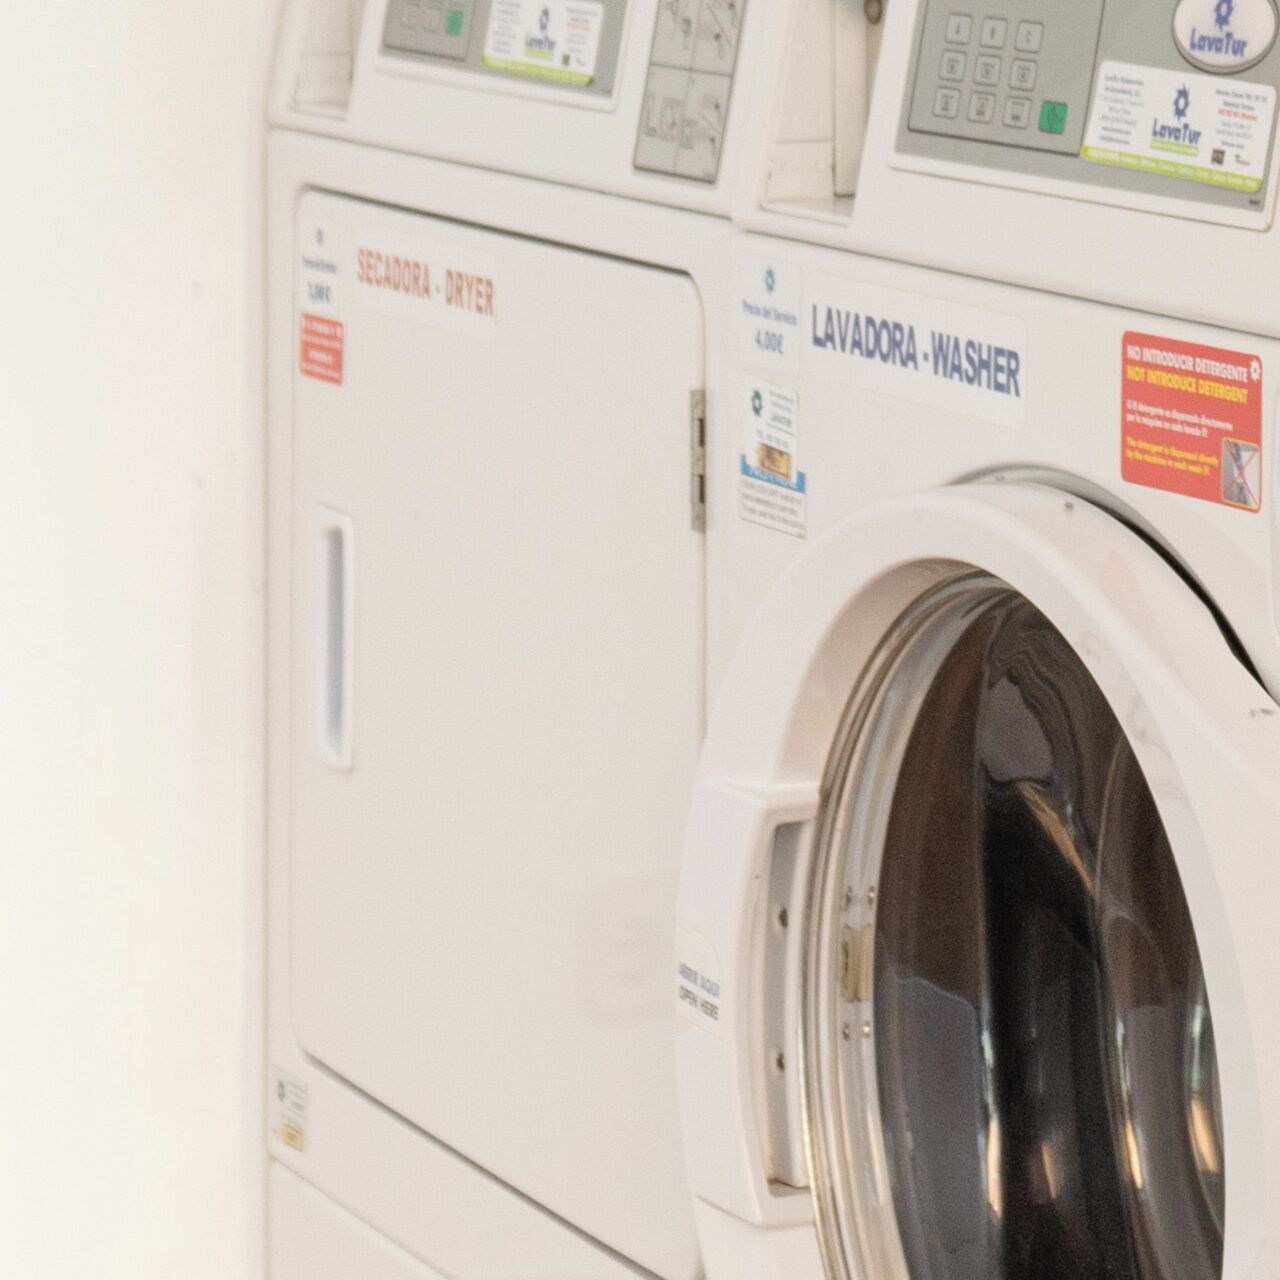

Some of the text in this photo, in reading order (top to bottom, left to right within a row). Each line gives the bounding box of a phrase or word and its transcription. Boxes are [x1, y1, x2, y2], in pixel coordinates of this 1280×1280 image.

[1189, 26, 1247, 58] LavaTur
[1152, 118, 1202, 145] LavaTur
[357, 246, 431, 300] SECADORA
[446, 269, 494, 317] DRYER
[755, 329, 784, 354] 4,00€
[812, 303, 1021, 397] LAVADORA WASHER
[1127, 344, 1248, 383] NO INTRODUCIR DETERGENTE
[1127, 366, 1248, 404] NOT INTRODUCE DETERGENT
